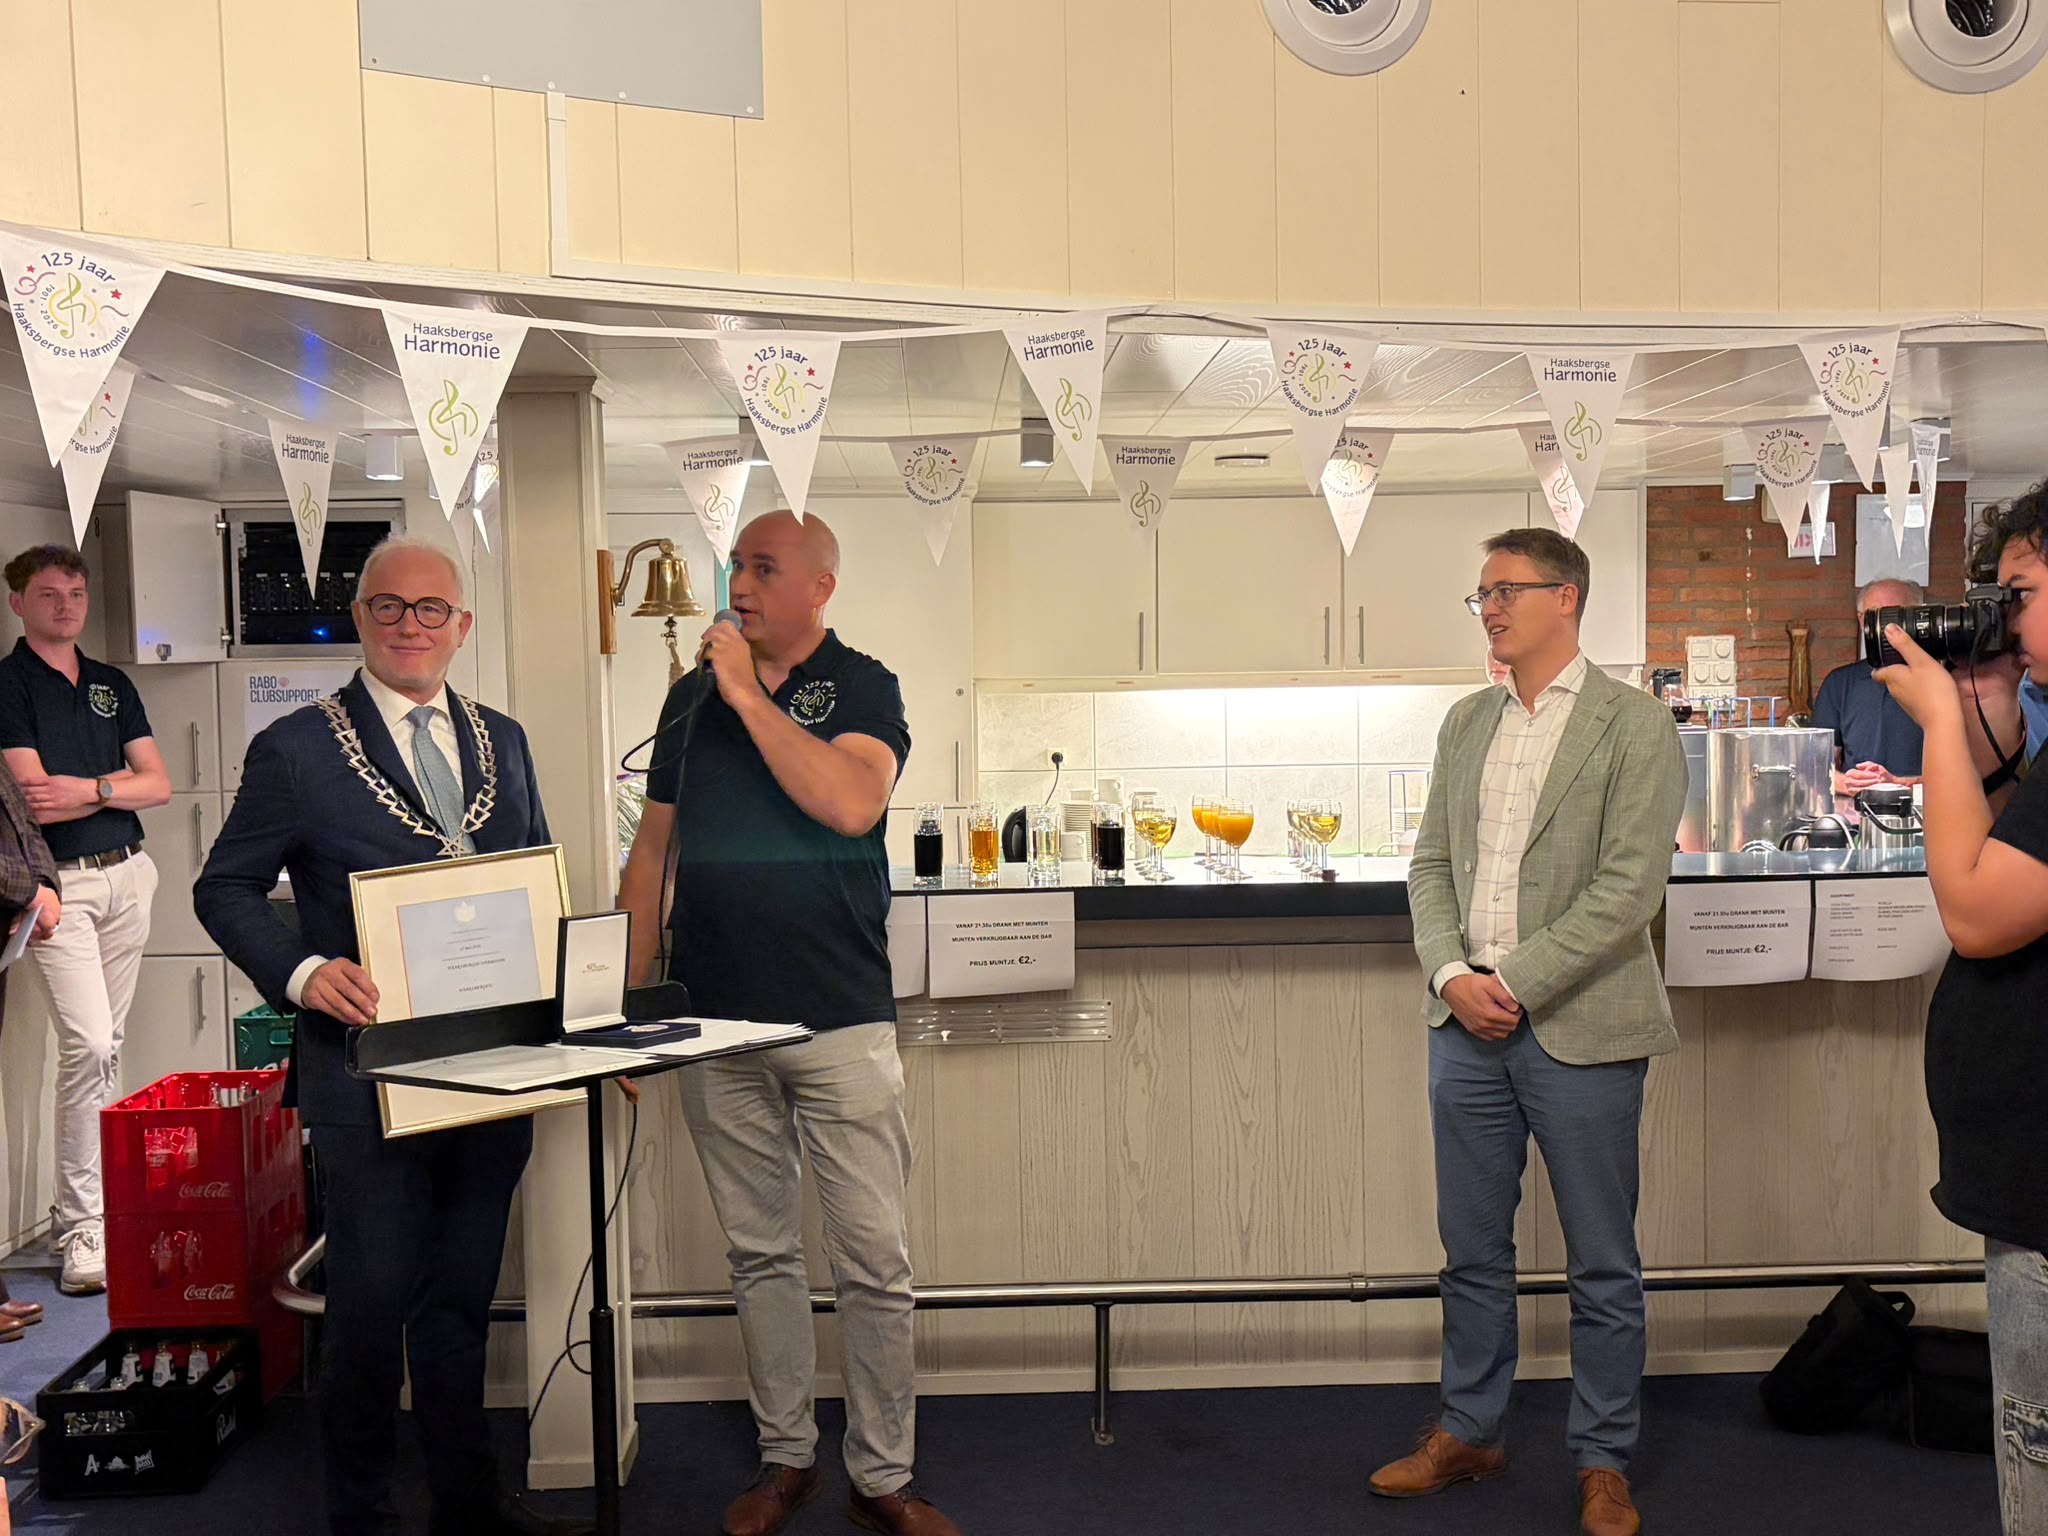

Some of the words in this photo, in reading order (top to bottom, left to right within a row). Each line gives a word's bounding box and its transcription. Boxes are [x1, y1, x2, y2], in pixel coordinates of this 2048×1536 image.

[41, 252, 74, 267] 125
[77, 256, 116, 283] jaar
[40, 309, 59, 330] 2026
[13, 302, 76, 357] Haaksbergse
[79, 325, 130, 358] Harmonie
[413, 322, 493, 342] Haaksbergse
[1028, 328, 1086, 345] Haaksbergse
[404, 333, 501, 359] Harmonie
[754, 346, 776, 362] 125
[780, 345, 808, 364] jaar
[1023, 338, 1095, 361] Harmonie
[1298, 338, 1319, 351] 125
[1321, 339, 1348, 357] jaar
[1827, 343, 1846, 358] 125
[1848, 342, 1873, 355] jaar
[1550, 358, 1611, 370] Haaksbergse
[1544, 367, 1617, 382] Harmonie
[1281, 380, 1323, 417] Haaksbergse
[1325, 388, 1358, 417] Harmonie
[1821, 389, 1864, 418] Haaksbergse
[1864, 380, 1890, 414] Harmonie
[745, 397, 797, 435] Haaksbergse
[797, 396, 828, 432] Harmonie
[90, 425, 117, 454] Harmonie
[1765, 428, 1782, 440] 125
[1784, 427, 1805, 439] jaar
[912, 445, 930, 457] 125
[931, 444, 953, 457] jaar
[1121, 445, 1172, 455] Haaksbergse
[1335, 437, 1347, 448] 25
[1349, 437, 1369, 451] jaar
[281, 443, 330, 464] Harmonie
[687, 448, 738, 460] Haaksbergse
[1116, 453, 1176, 466] Harmonie
[682, 455, 744, 472] Harmonie
[249, 676, 277, 689] RABO
[250, 689, 320, 703] CLUBSUPPORT
[1754, 944, 1773, 954] €2,-
[1018, 955, 1037, 965] €2,-
